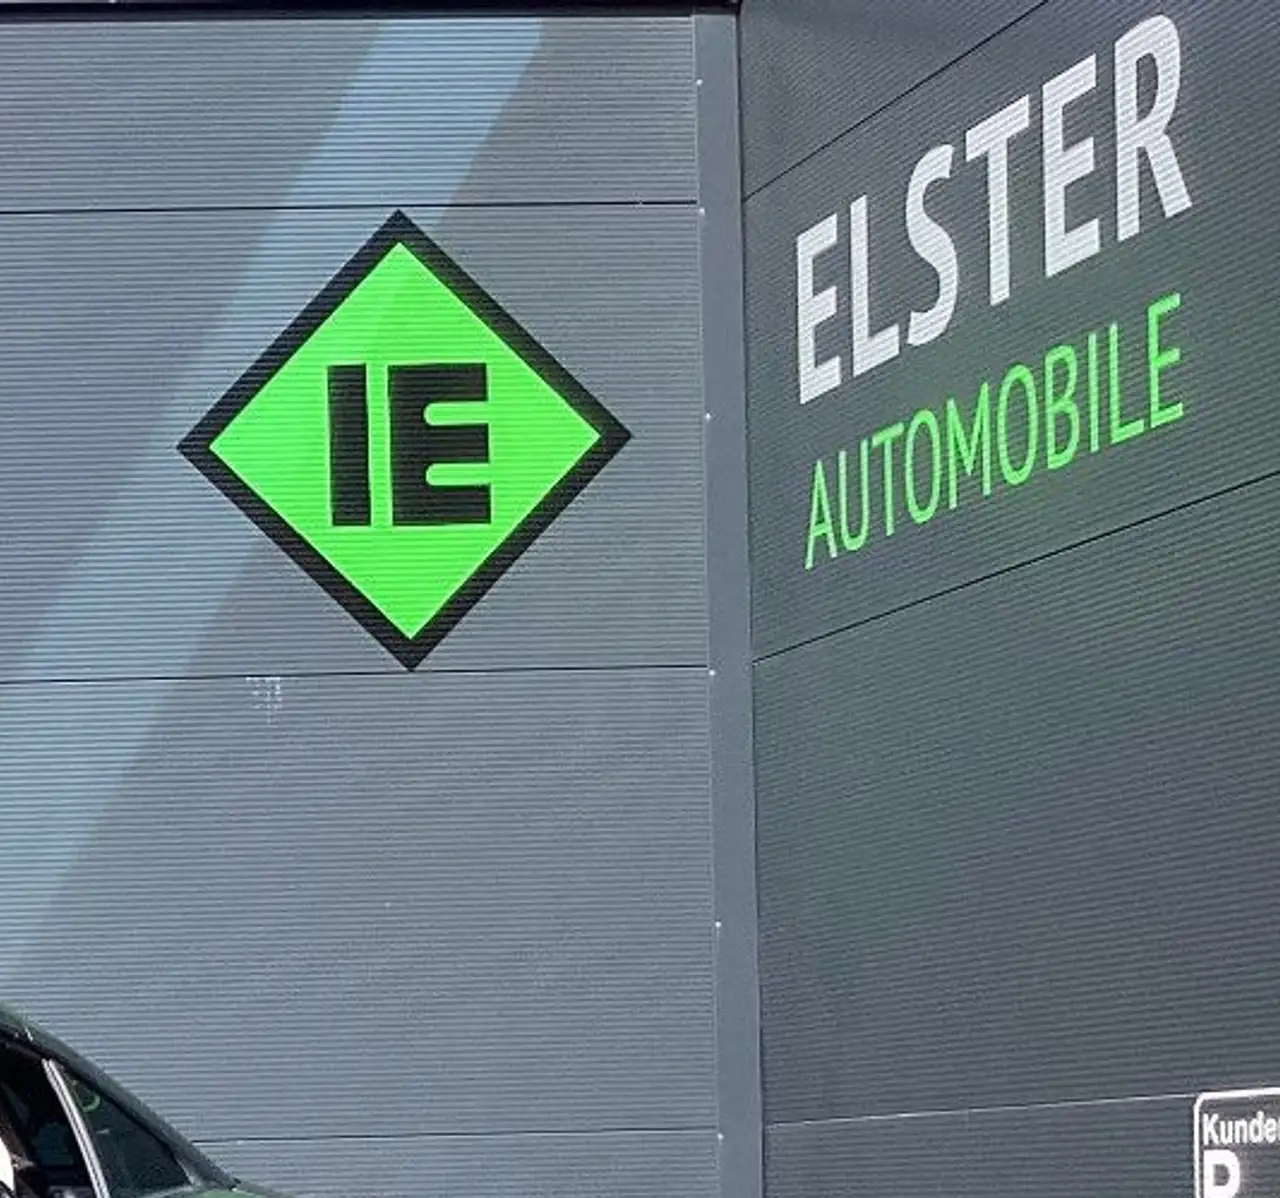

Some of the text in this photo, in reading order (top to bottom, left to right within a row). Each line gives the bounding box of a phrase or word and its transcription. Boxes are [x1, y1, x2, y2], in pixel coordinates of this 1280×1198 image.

[796, 14, 1192, 405] ELSTER
[327, 363, 492, 527] IE
[804, 292, 1183, 570] AUTOMOBILE
[1202, 1110, 1280, 1146] Kunde
